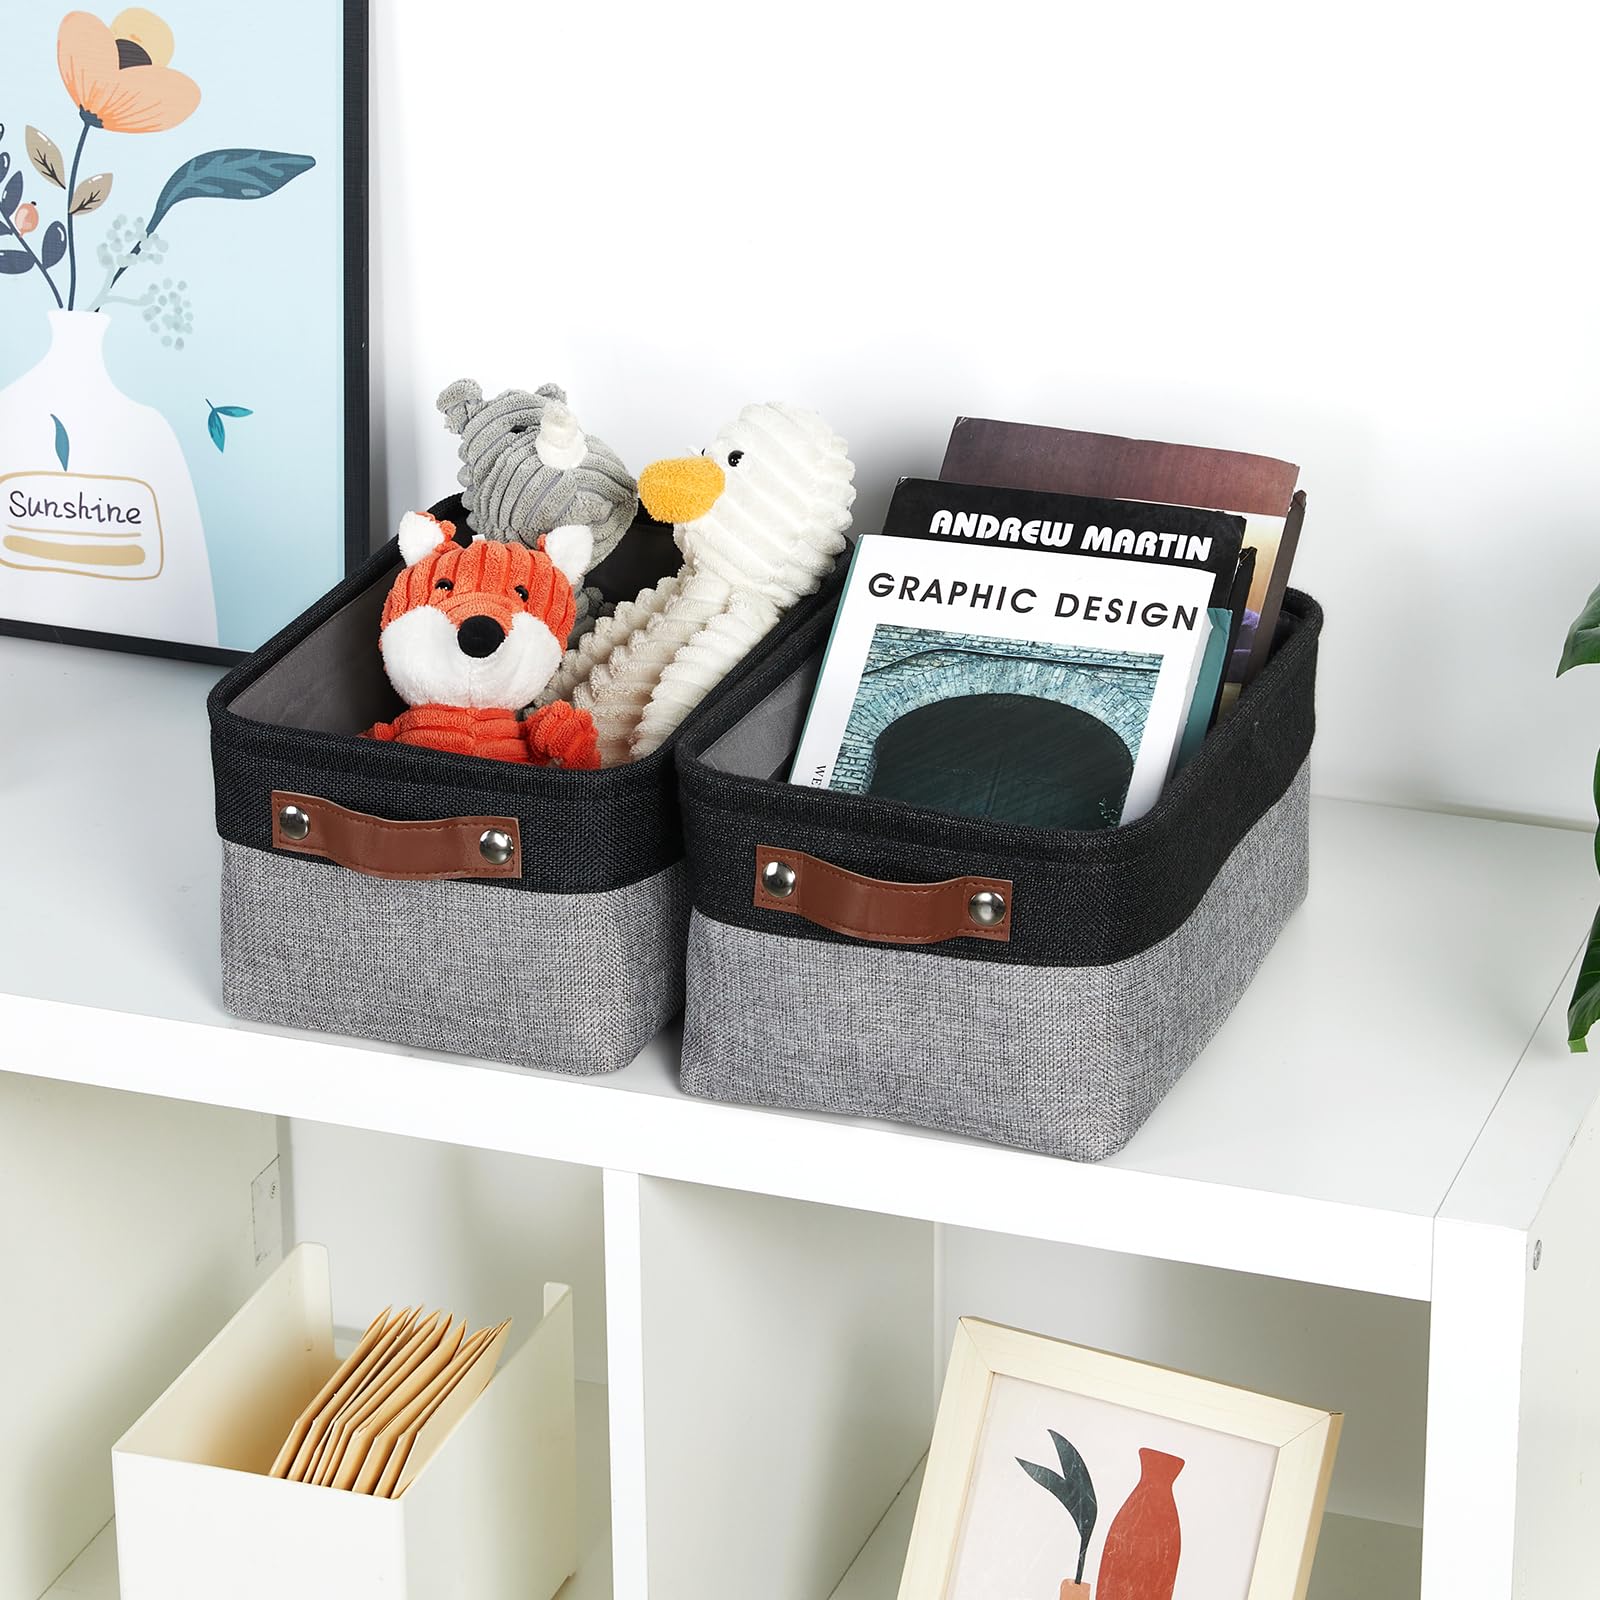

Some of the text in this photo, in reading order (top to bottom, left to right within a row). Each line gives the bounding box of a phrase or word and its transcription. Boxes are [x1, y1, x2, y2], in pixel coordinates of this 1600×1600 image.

[9, 490, 142, 525] Sunshine
[928, 509, 1213, 562] ANDREW MARTIN
[868, 572, 1199, 631] GRAPHIC DESIGN
